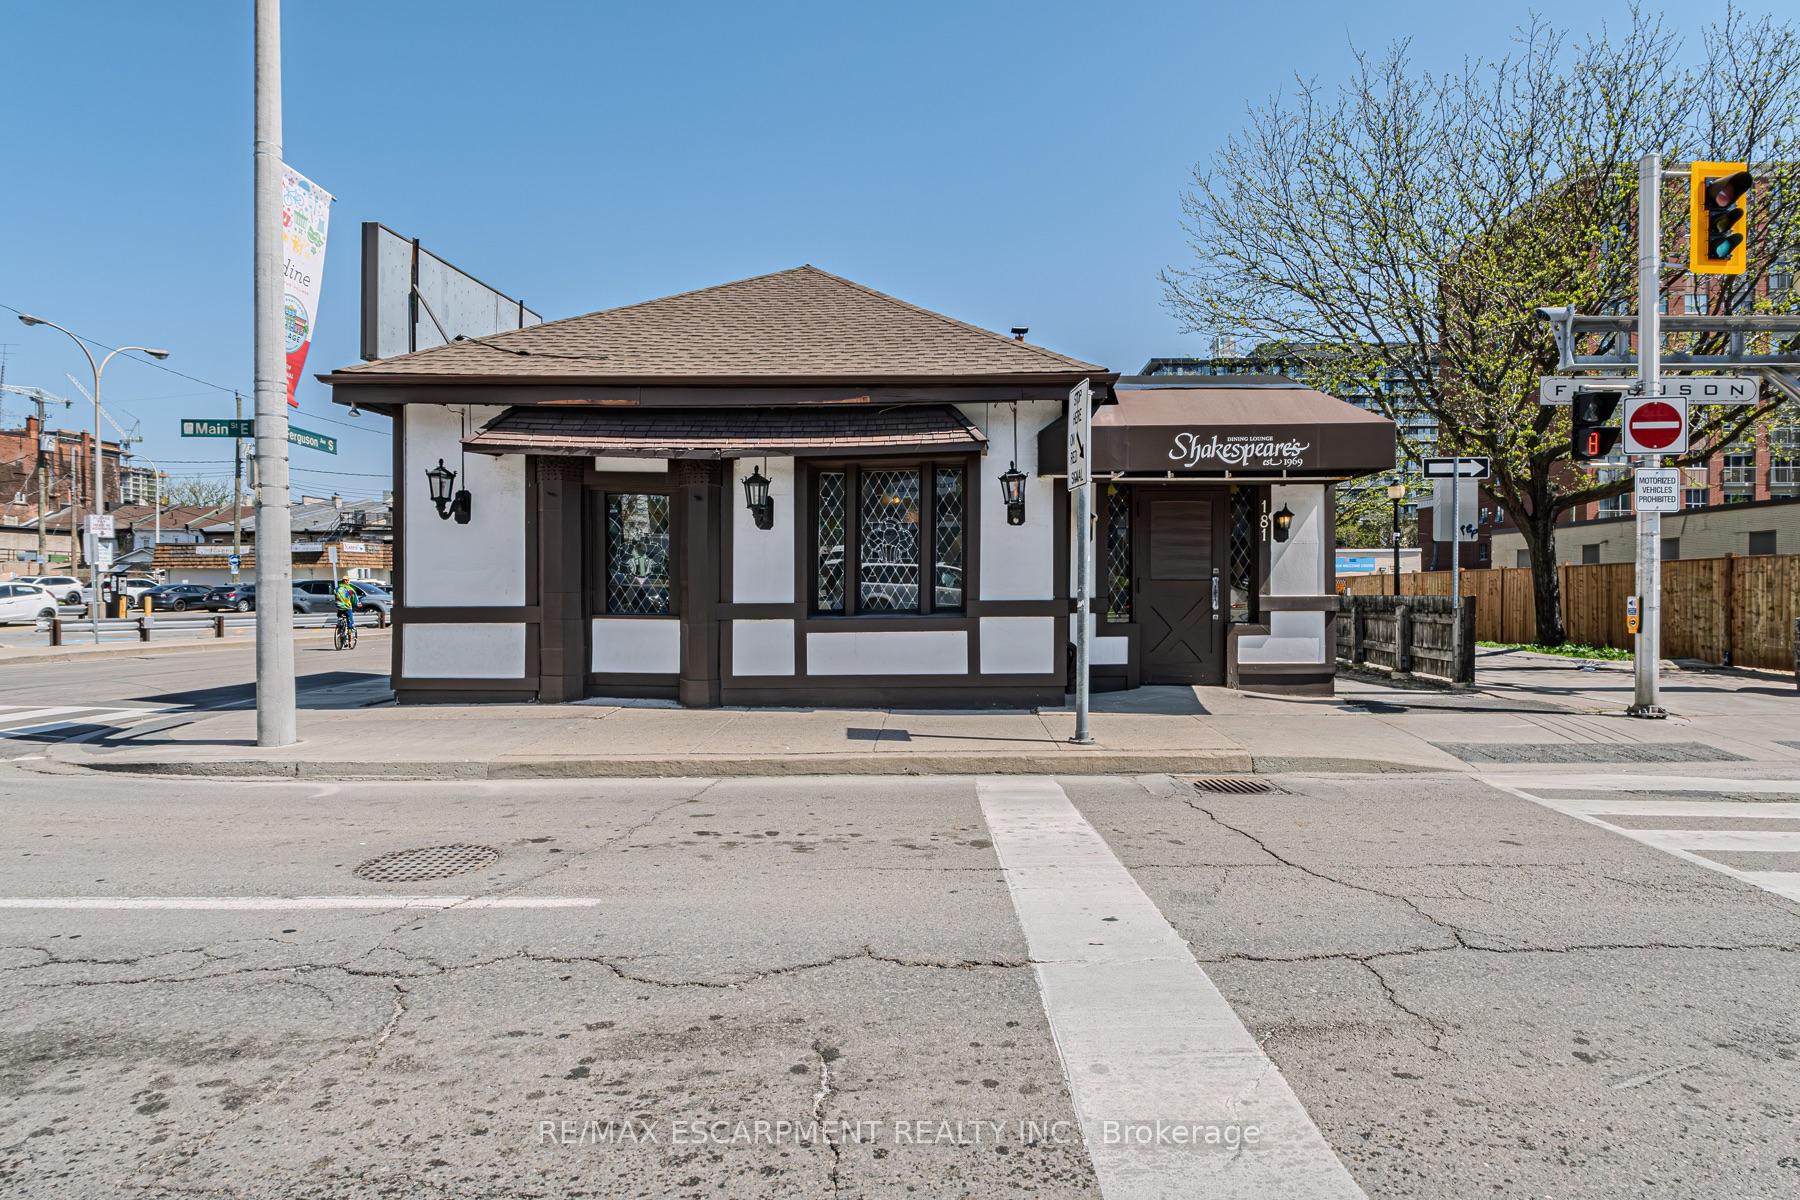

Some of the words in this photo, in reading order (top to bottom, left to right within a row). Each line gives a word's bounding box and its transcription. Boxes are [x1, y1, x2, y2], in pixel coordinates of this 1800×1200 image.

[1073, 389, 1083, 407] STOP
[1072, 407, 1083, 425] HERE
[195, 421, 229, 435] Main
[240, 422, 249, 435] E
[287, 428, 319, 448] erguson
[327, 439, 334, 451] S
[1168, 432, 1310, 467] Shakespeare's
[1283, 456, 1303, 467] 1969
[1638, 476, 1676, 485] MOTORIZED
[1641, 486, 1673, 494] VEHICLES
[1638, 495, 1677, 503] PROHIBITED
[1260, 499, 1269, 542] 181
